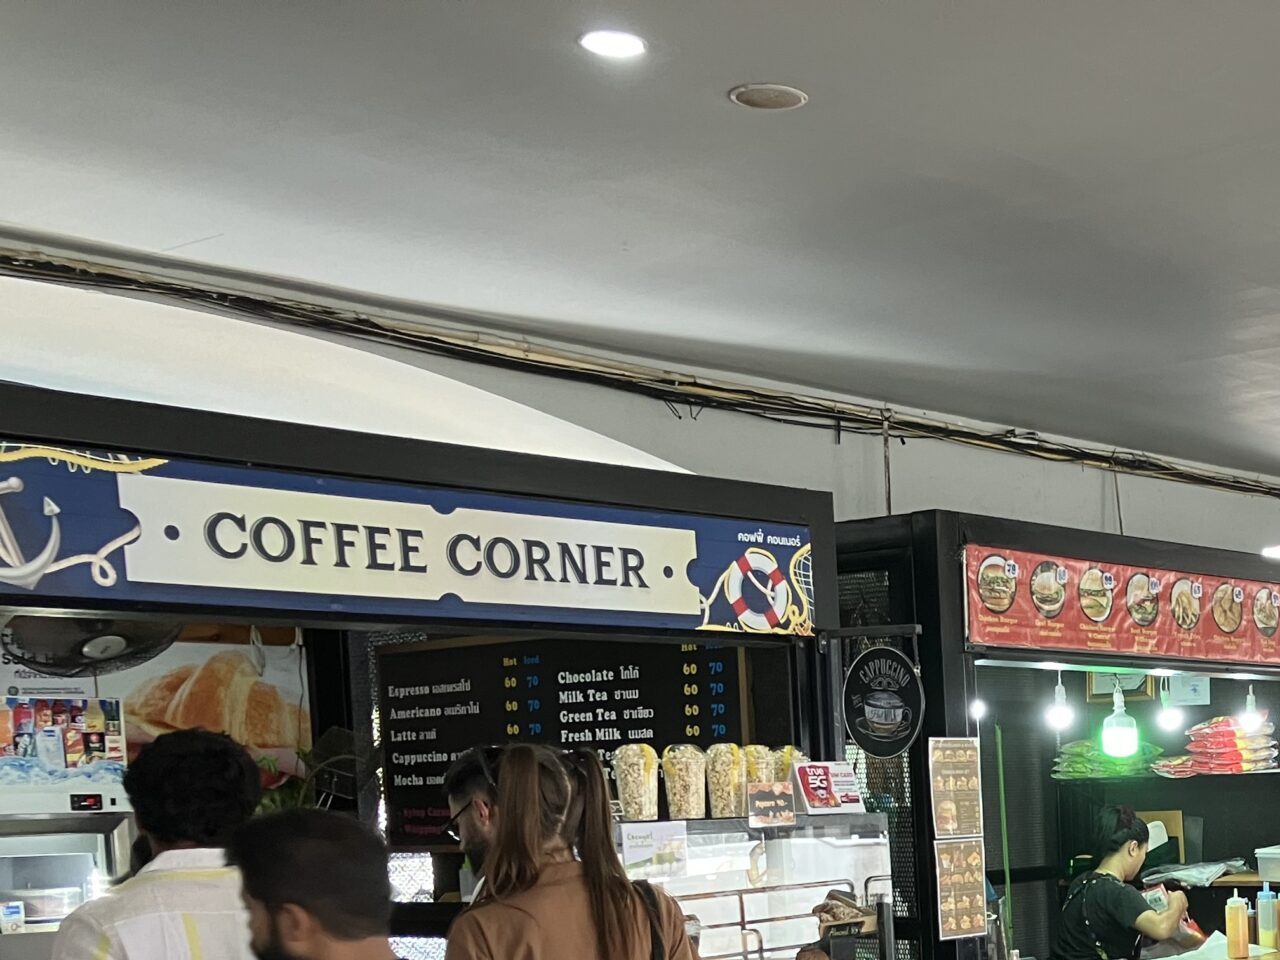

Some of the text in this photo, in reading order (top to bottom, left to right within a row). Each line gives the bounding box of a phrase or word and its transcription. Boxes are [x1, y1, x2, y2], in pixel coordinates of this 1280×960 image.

[204, 511, 650, 589] COFFEE CORNER
[503, 657, 517, 667] Hot
[558, 669, 614, 684] Chocolate
[683, 663, 698, 675] 60
[709, 661, 724, 674] 70
[859, 658, 911, 687] CAPPUCCINO
[388, 685, 430, 699] Espresso
[504, 677, 517, 689] 60
[526, 675, 539, 688] 70
[559, 690, 584, 704] Milk
[587, 689, 608, 702] Tea
[684, 684, 698, 696] 60
[710, 683, 725, 696] 70
[390, 706, 442, 720] Americano
[505, 700, 518, 712] 60
[527, 699, 541, 711] 70
[560, 710, 593, 723] Green
[596, 708, 617, 721] Tea
[685, 704, 699, 717] 60
[711, 703, 725, 717] 70
[390, 729, 417, 742] Latte
[507, 723, 520, 736] 60
[529, 723, 542, 736] 70
[561, 730, 593, 743] Fresh
[595, 728, 621, 741] Milk
[685, 725, 700, 737] 60
[712, 724, 726, 737] 70
[392, 750, 449, 766] Cappuccino
[394, 773, 424, 787] Mocha
[805, 767, 825, 776] true
[808, 775, 828, 788] 5G
